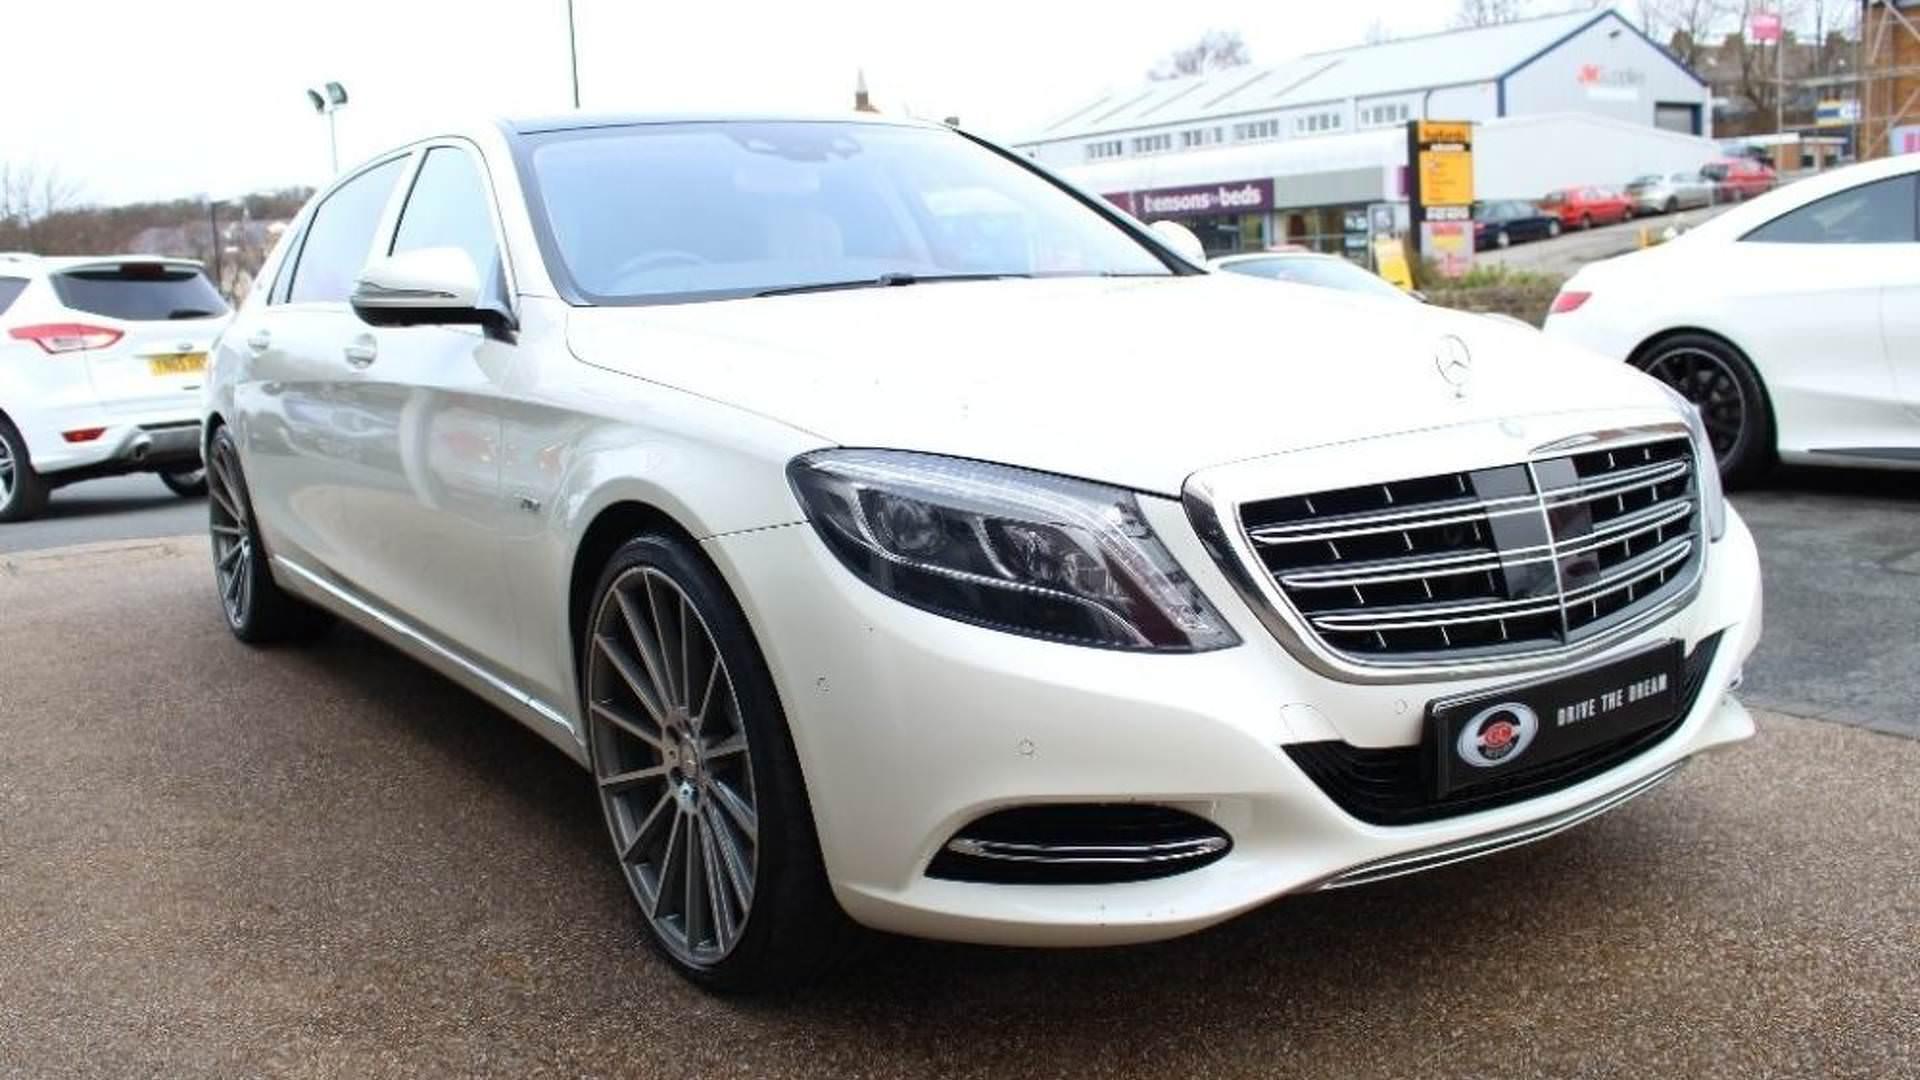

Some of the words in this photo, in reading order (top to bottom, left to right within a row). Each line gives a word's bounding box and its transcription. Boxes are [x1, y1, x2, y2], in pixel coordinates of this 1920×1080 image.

[1219, 184, 1262, 207] beds
[1557, 698, 1596, 727] DRIVE
[1600, 688, 1624, 712] THE
[1628, 672, 1667, 703] DREAM
